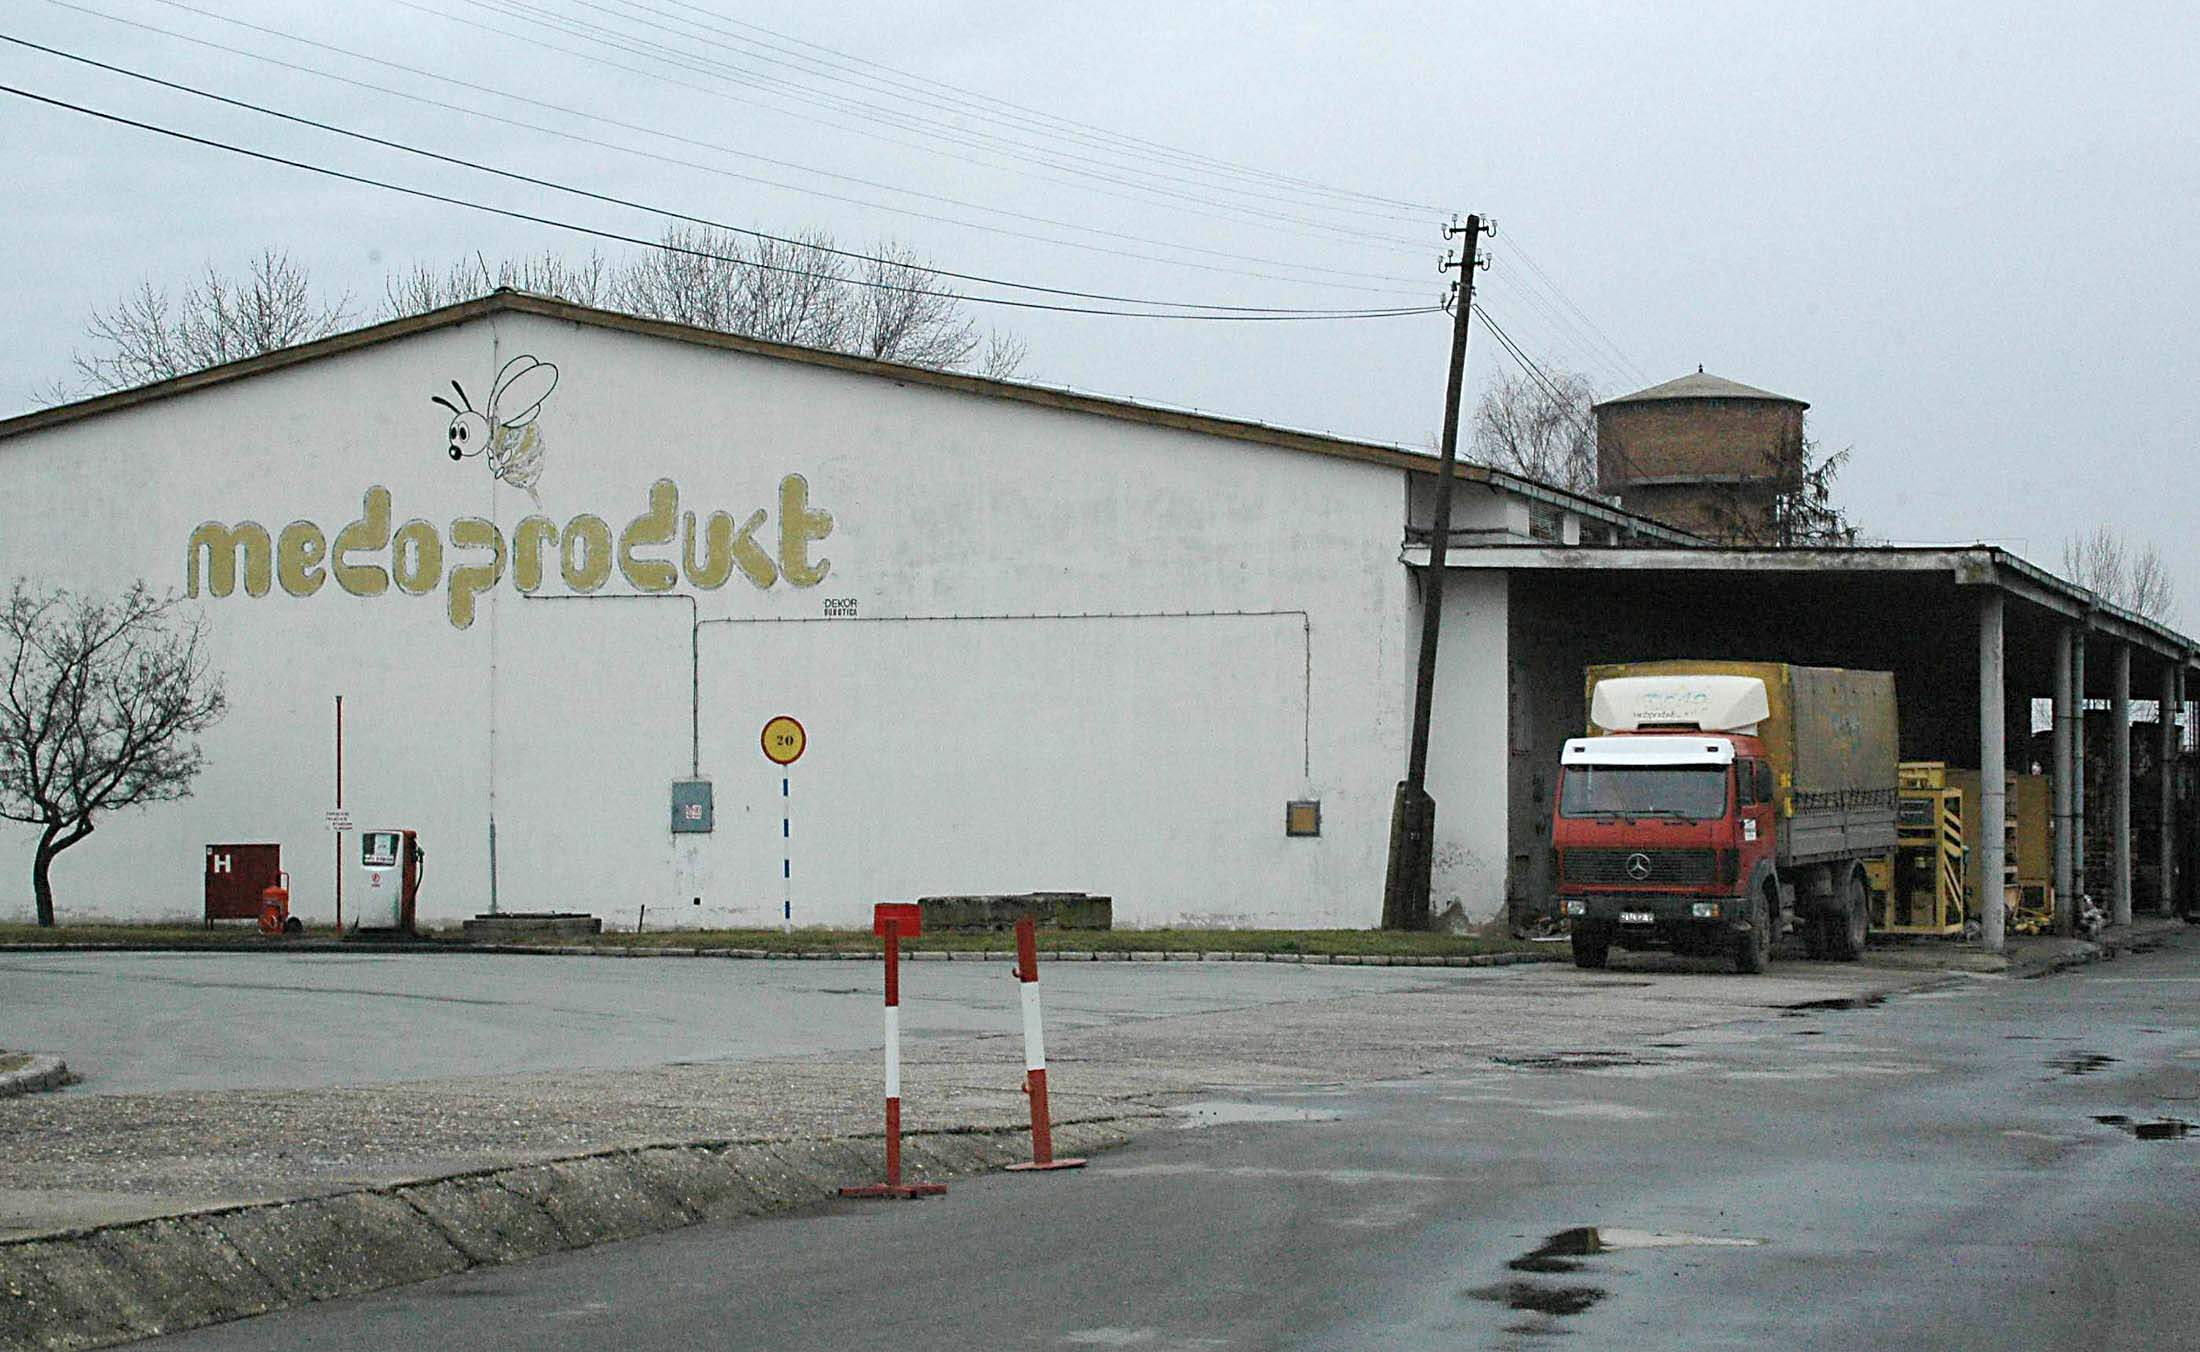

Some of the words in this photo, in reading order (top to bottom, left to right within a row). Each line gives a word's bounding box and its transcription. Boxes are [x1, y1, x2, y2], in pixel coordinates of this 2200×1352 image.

[186, 473, 834, 630] medoprodukt
[824, 598, 857, 608] DEKOR
[776, 735, 794, 746] 20
[214, 854, 231, 873] H
